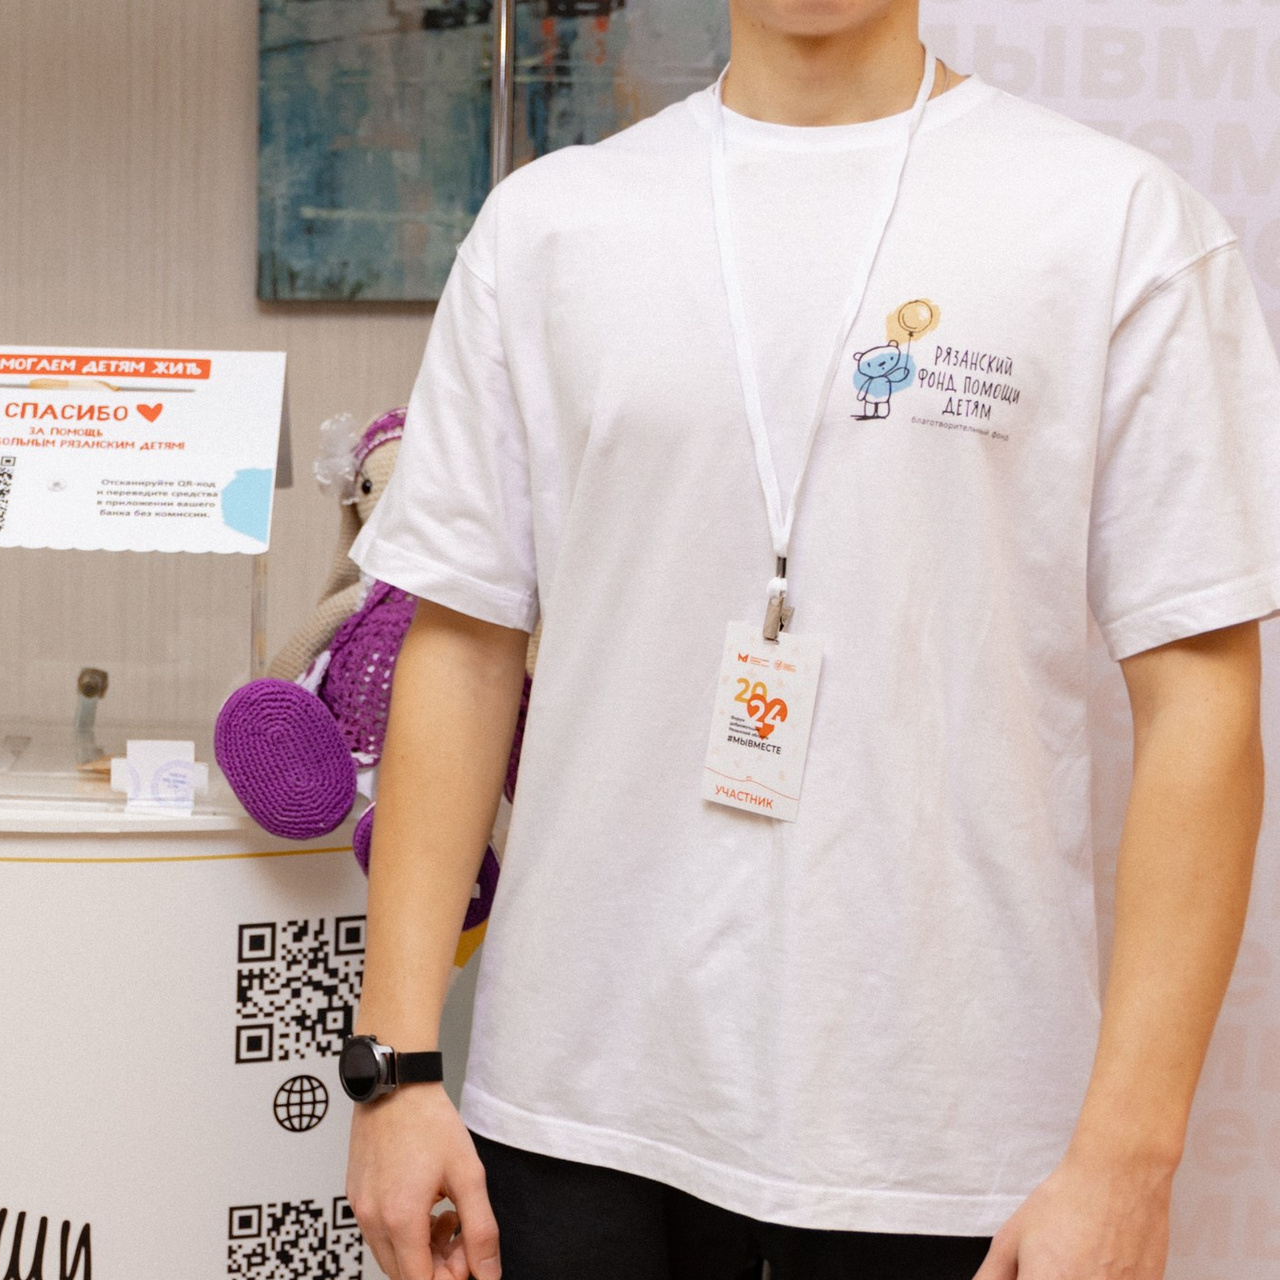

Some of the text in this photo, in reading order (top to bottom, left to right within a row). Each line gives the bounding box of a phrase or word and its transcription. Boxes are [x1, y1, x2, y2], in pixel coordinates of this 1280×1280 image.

[82, 359, 146, 375] ДЕТЯМ
[152, 361, 202, 376] ЖИТЬ
[933, 345, 1013, 376] РЯЗАНСКИЙ
[917, 368, 1021, 405] ФОНД ПОМОЩИ
[4, 402, 129, 421] СПАСИБО
[942, 397, 992, 421] ДЕТЯМ
[29, 427, 103, 438] ЗА ПОМОЩЬ
[60, 439, 135, 450] РЯЗАНСКИМ
[101, 479, 216, 489] Отсканируйте QR-код
[106, 490, 168, 498] переведите
[100, 509, 131, 517] банка
[134, 509, 152, 517] без
[727, 734, 782, 755] #МЫВМЕСТЕ
[715, 784, 773, 809] УЧАСТНИК
